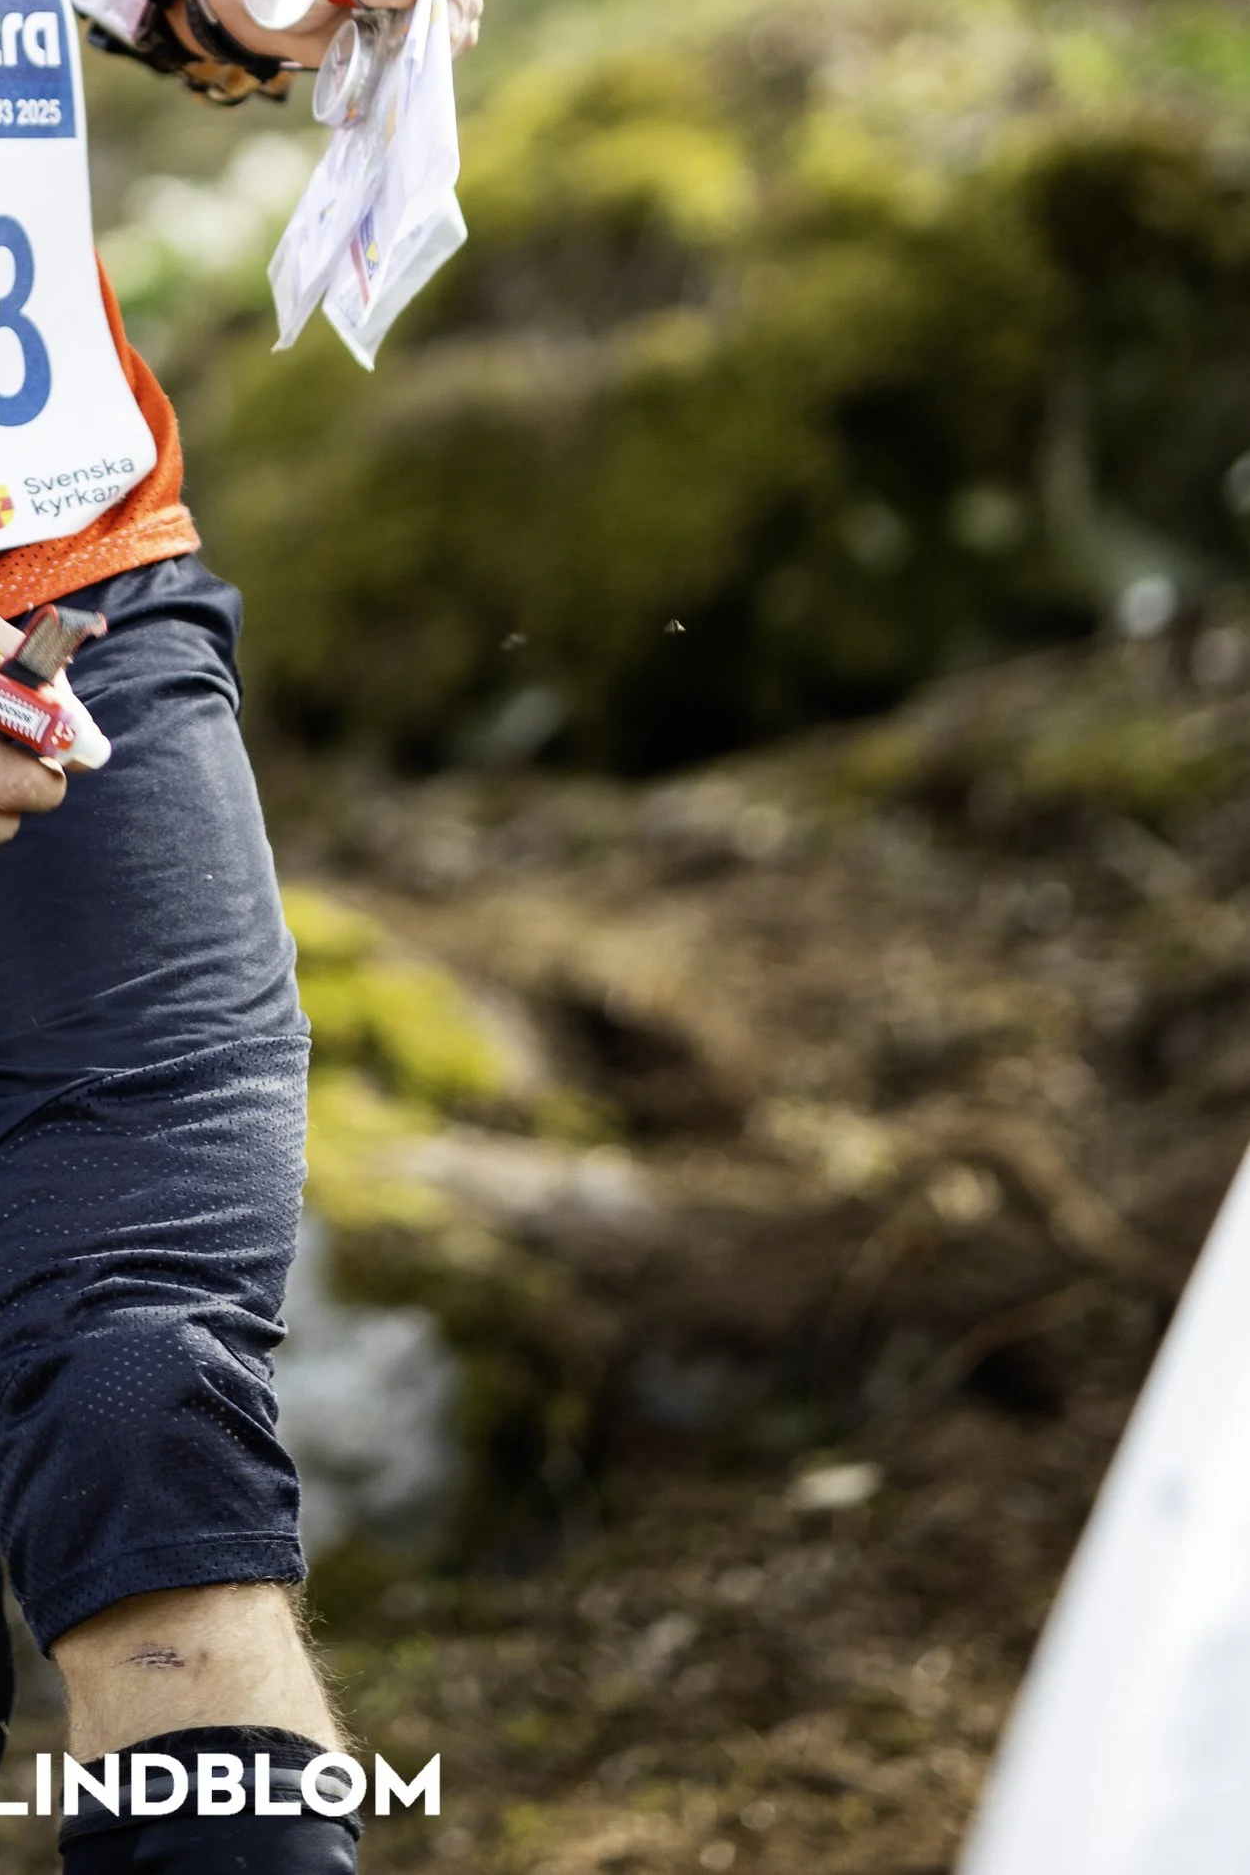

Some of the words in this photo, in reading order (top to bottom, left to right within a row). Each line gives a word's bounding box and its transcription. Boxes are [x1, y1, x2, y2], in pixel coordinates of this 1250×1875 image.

[16, 98, 63, 125] 2025
[23, 457, 136, 495] Svenska
[30, 484, 121, 518] kyrkan
